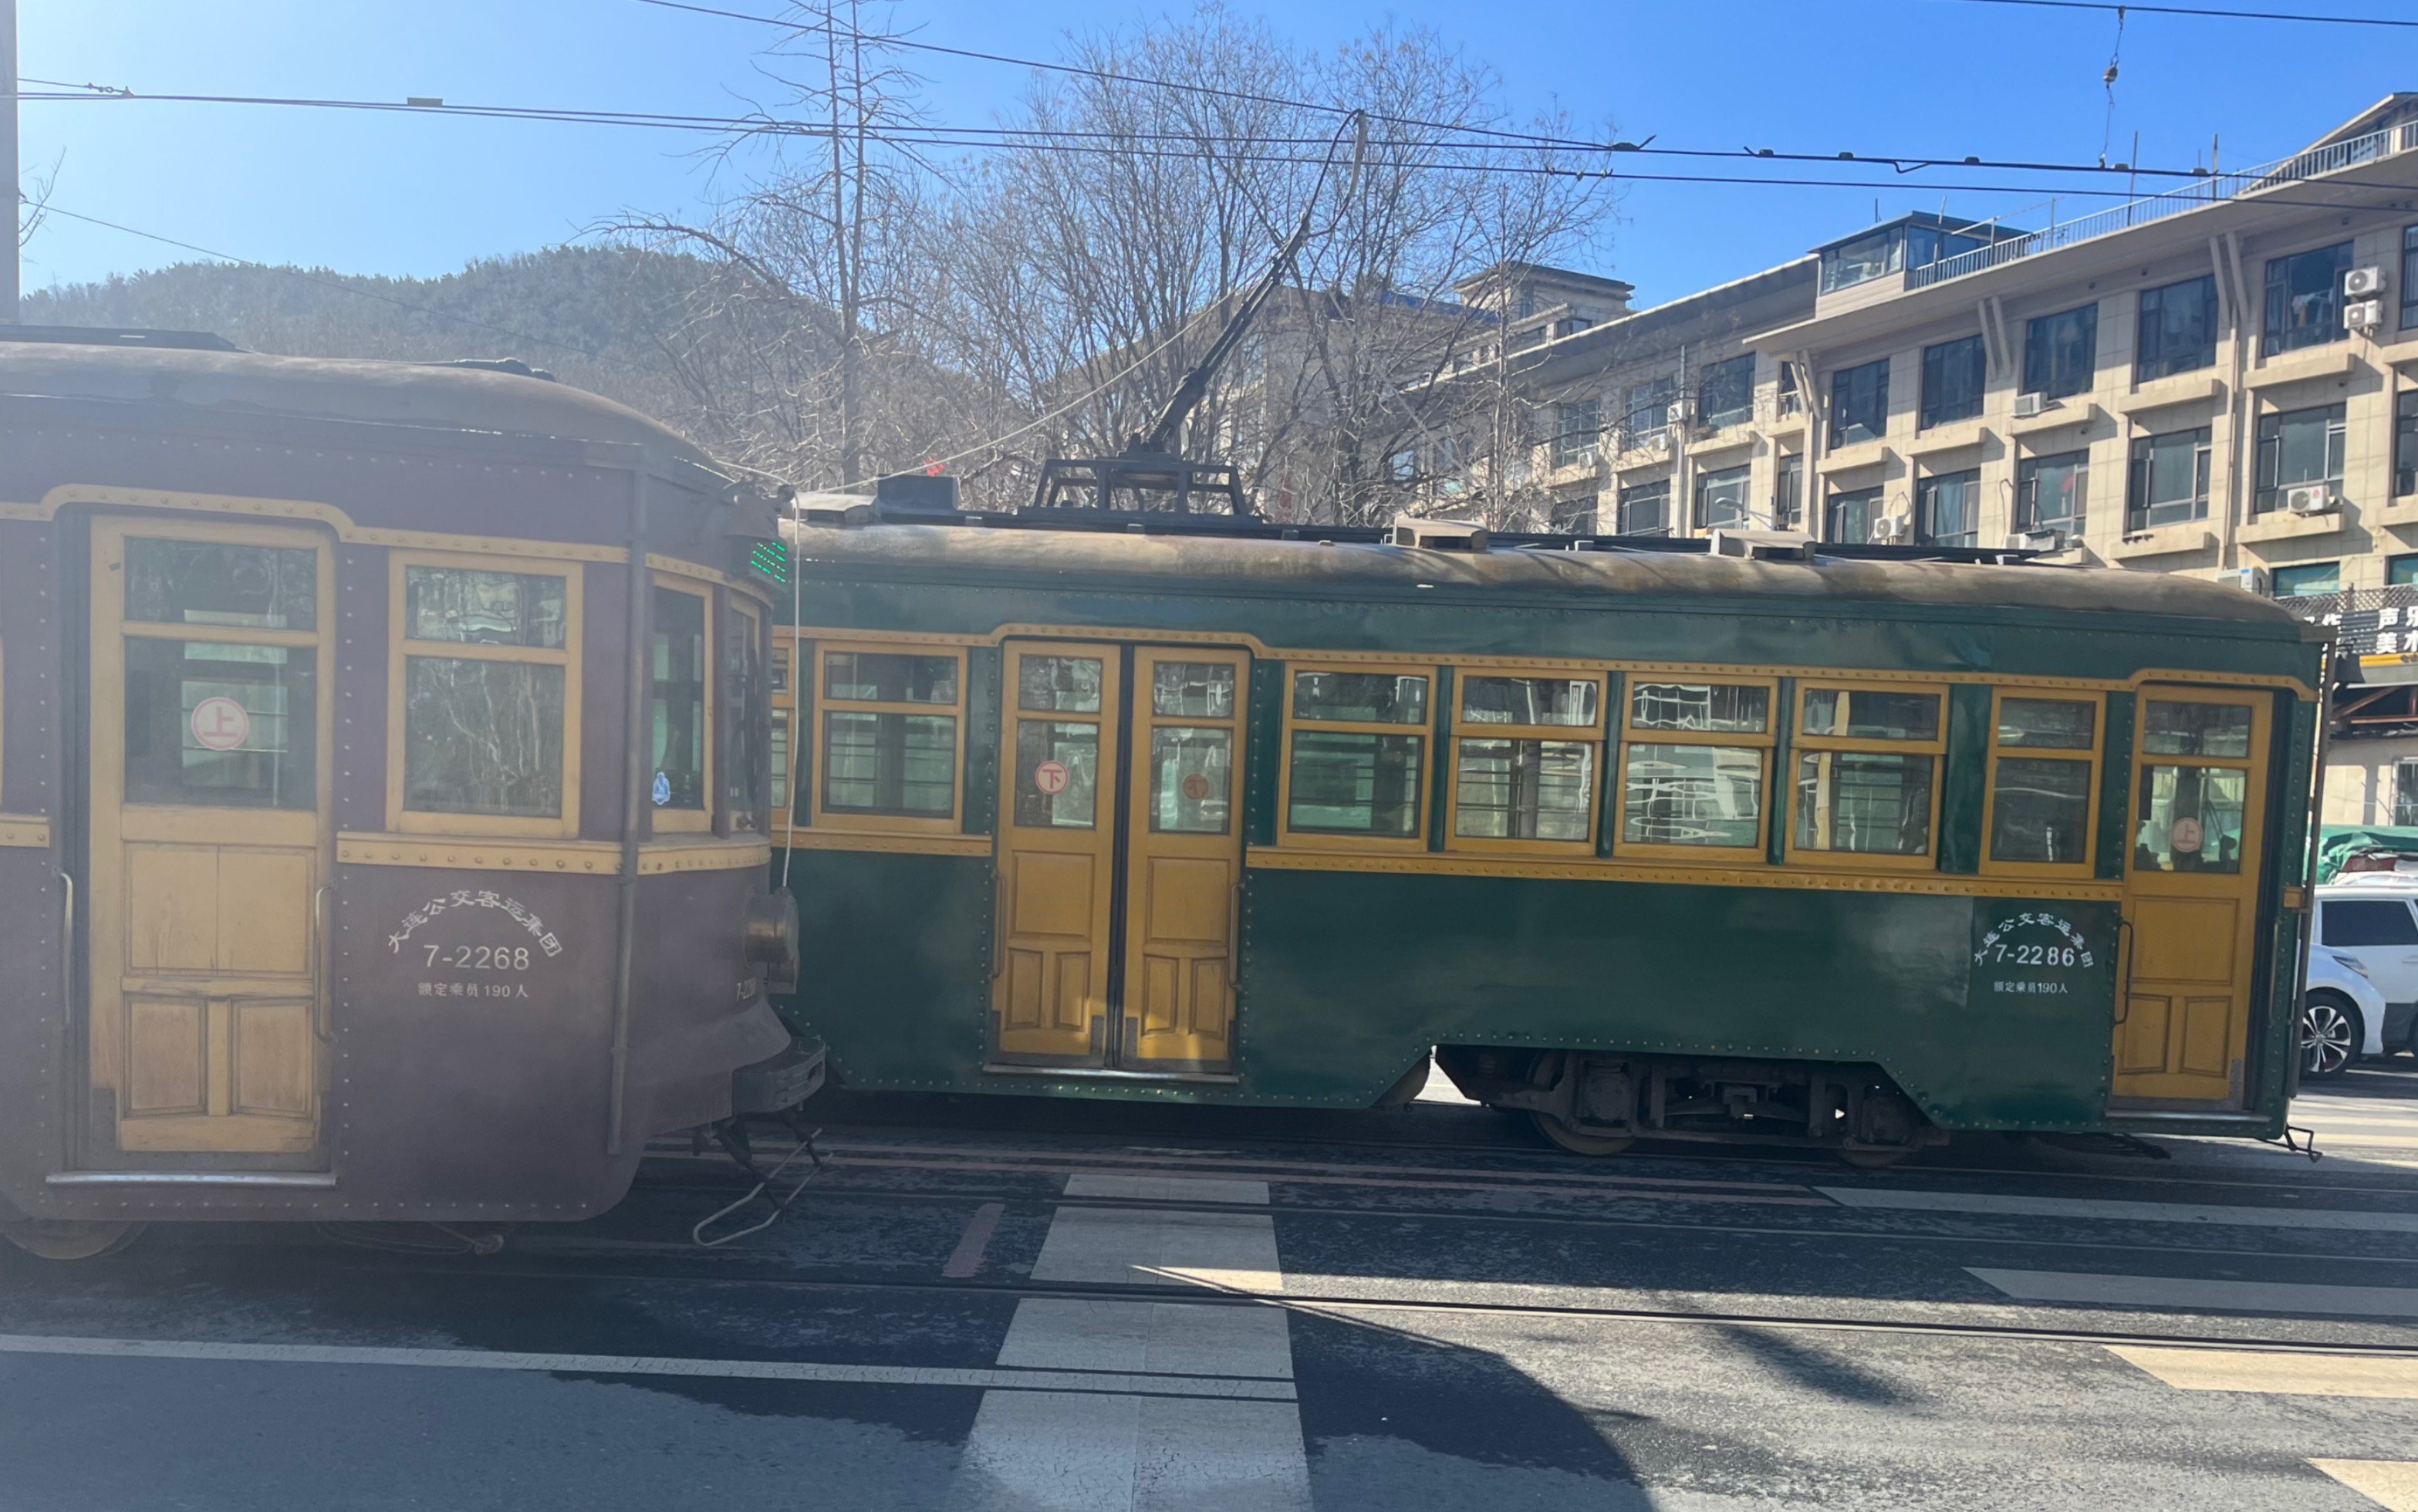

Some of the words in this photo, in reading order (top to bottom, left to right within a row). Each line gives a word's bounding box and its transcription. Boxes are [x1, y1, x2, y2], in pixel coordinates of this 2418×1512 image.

[202, 706, 238, 738] 上
[1042, 768, 1063, 790] 下
[2176, 822, 2196, 845] 上
[387, 889, 563, 957] 大连公交客运集团
[1974, 912, 2094, 968] 大连公交客运集团
[424, 943, 530, 970] 7-2268
[1995, 943, 2075, 967] 7-2286
